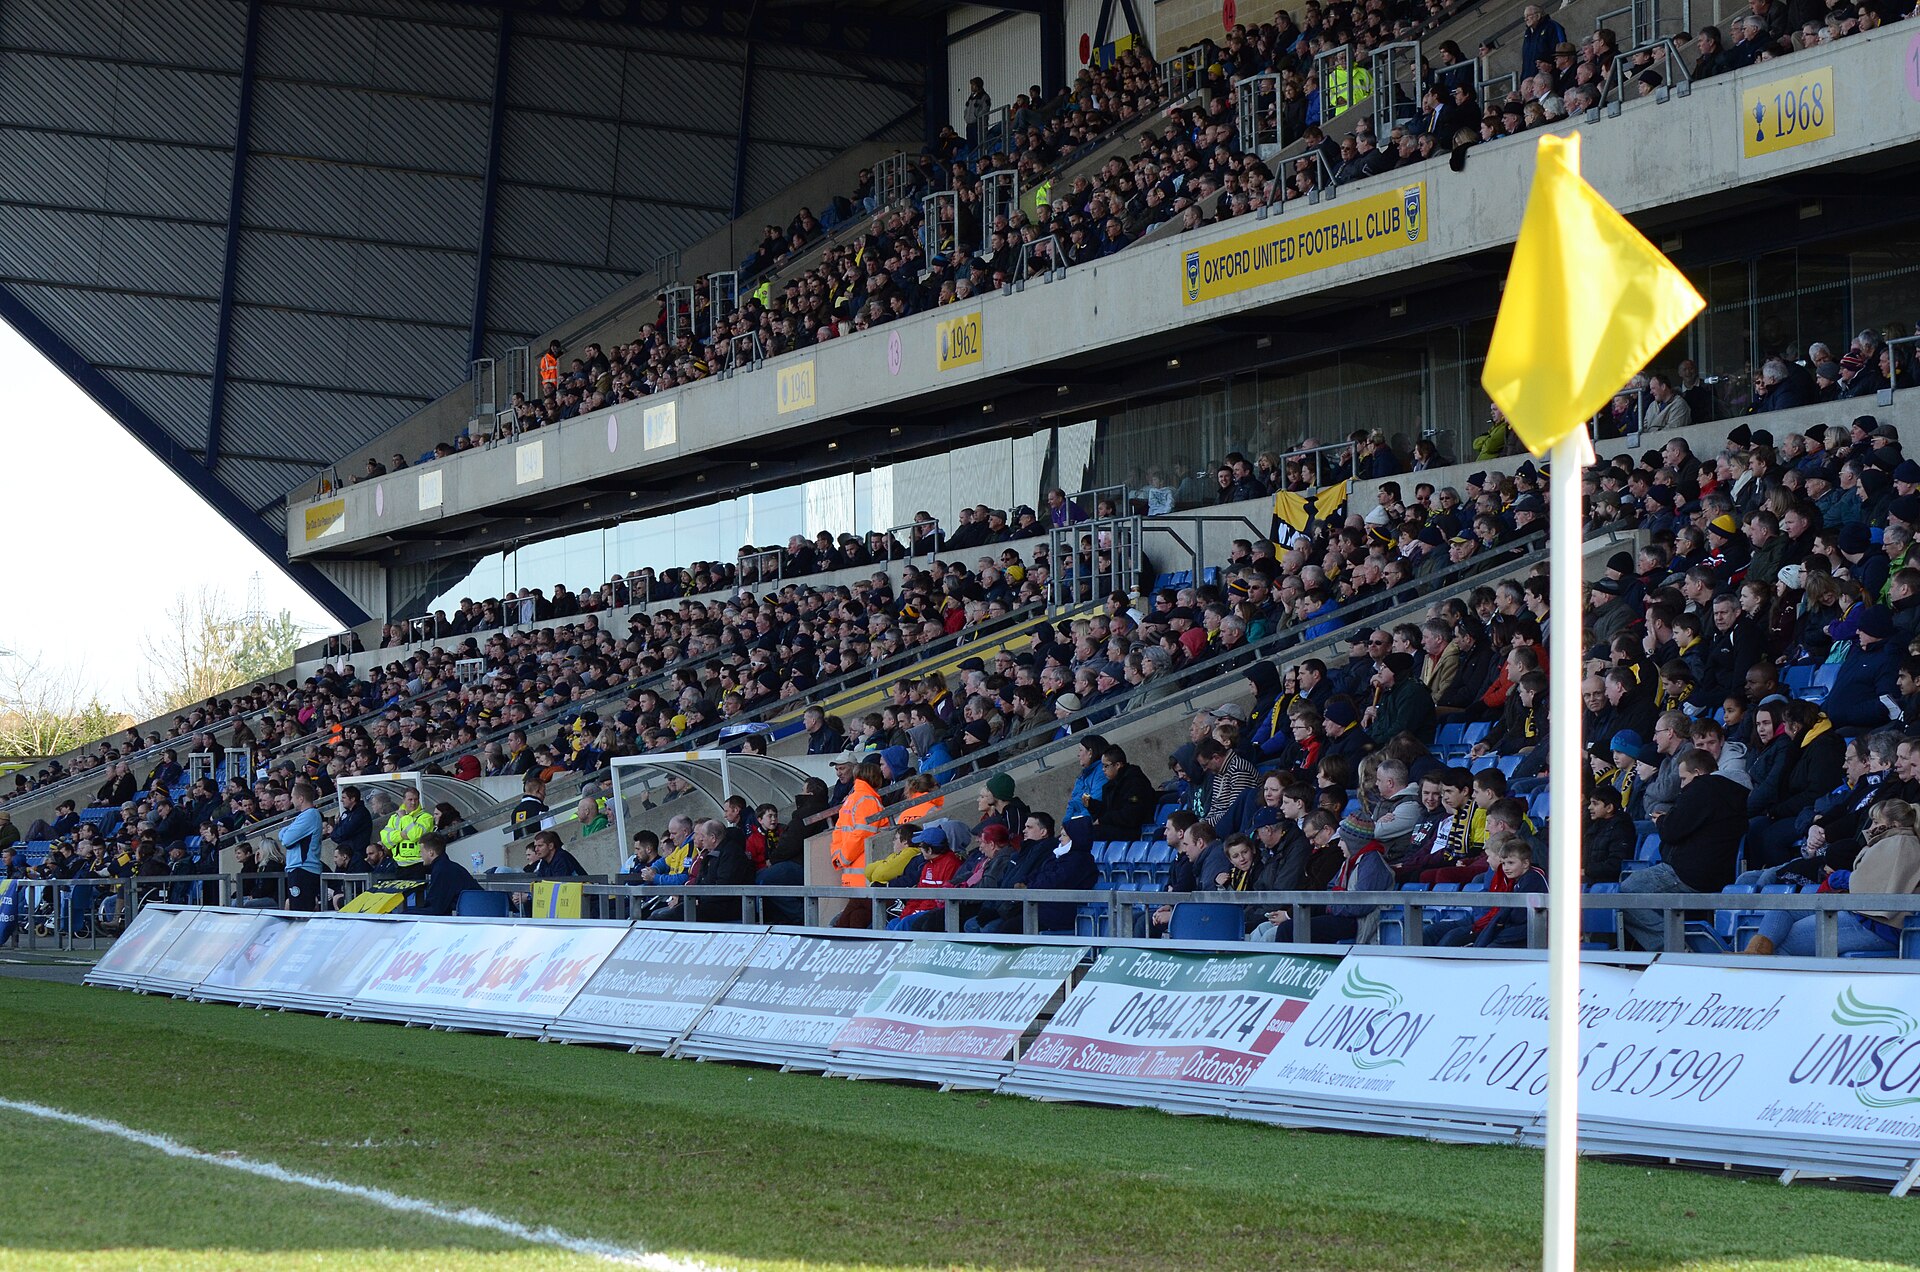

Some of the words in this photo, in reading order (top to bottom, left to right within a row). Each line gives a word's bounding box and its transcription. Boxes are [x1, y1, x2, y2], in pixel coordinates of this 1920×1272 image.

[1774, 82, 1824, 138] 1968
[1203, 248, 1251, 284] OXFORD
[1253, 237, 1294, 271] UNITED
[1298, 218, 1364, 257] FOOTBALL
[1366, 206, 1400, 236] CLUB
[890, 340, 901, 368] 13
[951, 321, 978, 360] 1962
[790, 369, 811, 405] 1961
[369, 946, 440, 990] JACK
[416, 949, 489, 994] JACK
[463, 951, 541, 999] JACK
[612, 928, 713, 965] BARTLETT'S
[701, 931, 801, 970] BUTCHERS
[785, 938, 806, 973] &
[801, 939, 882, 982] Baguette
[873, 942, 906, 975] B
[899, 941, 938, 966] Bespoke
[931, 944, 967, 968] Stone
[958, 947, 1006, 978] Masonry
[1008, 948, 1070, 977] Landscaping
[1126, 952, 1181, 993] Flooring
[1192, 957, 1253, 991] Fireplaces
[1267, 956, 1312, 989] Work
[375, 983, 412, 994] OXFORDSHIRE
[424, 985, 460, 997] OXFORDSHIRE
[472, 990, 513, 1003] OXFORDSHIRE
[517, 953, 600, 1004] JACK
[527, 993, 573, 1006] OXFORDSHIRE
[587, 967, 612, 994] Hog
[608, 968, 636, 992] Roast
[627, 972, 675, 998] Specialists
[671, 973, 720, 1003] Suppliers
[728, 980, 761, 1001] meat
[749, 980, 767, 1002] to
[762, 981, 785, 1005] the
[779, 983, 814, 1007] retail
[811, 986, 854, 1015] catering
[581, 1001, 614, 1020] HIGH
[609, 1004, 650, 1025] STREET
[646, 1006, 720, 1036] KIDLINGTON
[714, 1010, 748, 1035] OX5
[739, 1015, 772, 1038] 2DH
[804, 1020, 836, 1044] 373
[1108, 991, 1187, 1038] 01844
[1168, 994, 1220, 1041] 279
[1204, 995, 1273, 1043] 274
[1304, 1004, 1436, 1058] UNISON
[1611, 988, 1693, 1034] ounty
[1684, 992, 1786, 1032] Branch
[838, 1020, 881, 1046] Exclusive
[876, 1023, 912, 1051] Italian
[903, 1029, 954, 1056] Designed
[946, 1028, 987, 1057] Kitchens
[981, 1034, 1000, 1058] at
[1027, 1036, 1078, 1070] Gallery,
[1145, 1049, 1186, 1080] Thame,
[1428, 1032, 1496, 1084] Tel:
[1591, 1043, 1745, 1102] 815990
[1276, 1059, 1297, 1080] the
[1288, 1062, 1330, 1088] public
[1323, 1069, 1365, 1091] service
[1360, 1076, 1397, 1093] union
[1756, 1099, 1780, 1122] the
[1774, 1104, 1824, 1129] public
[1823, 1109, 1880, 1132] service
